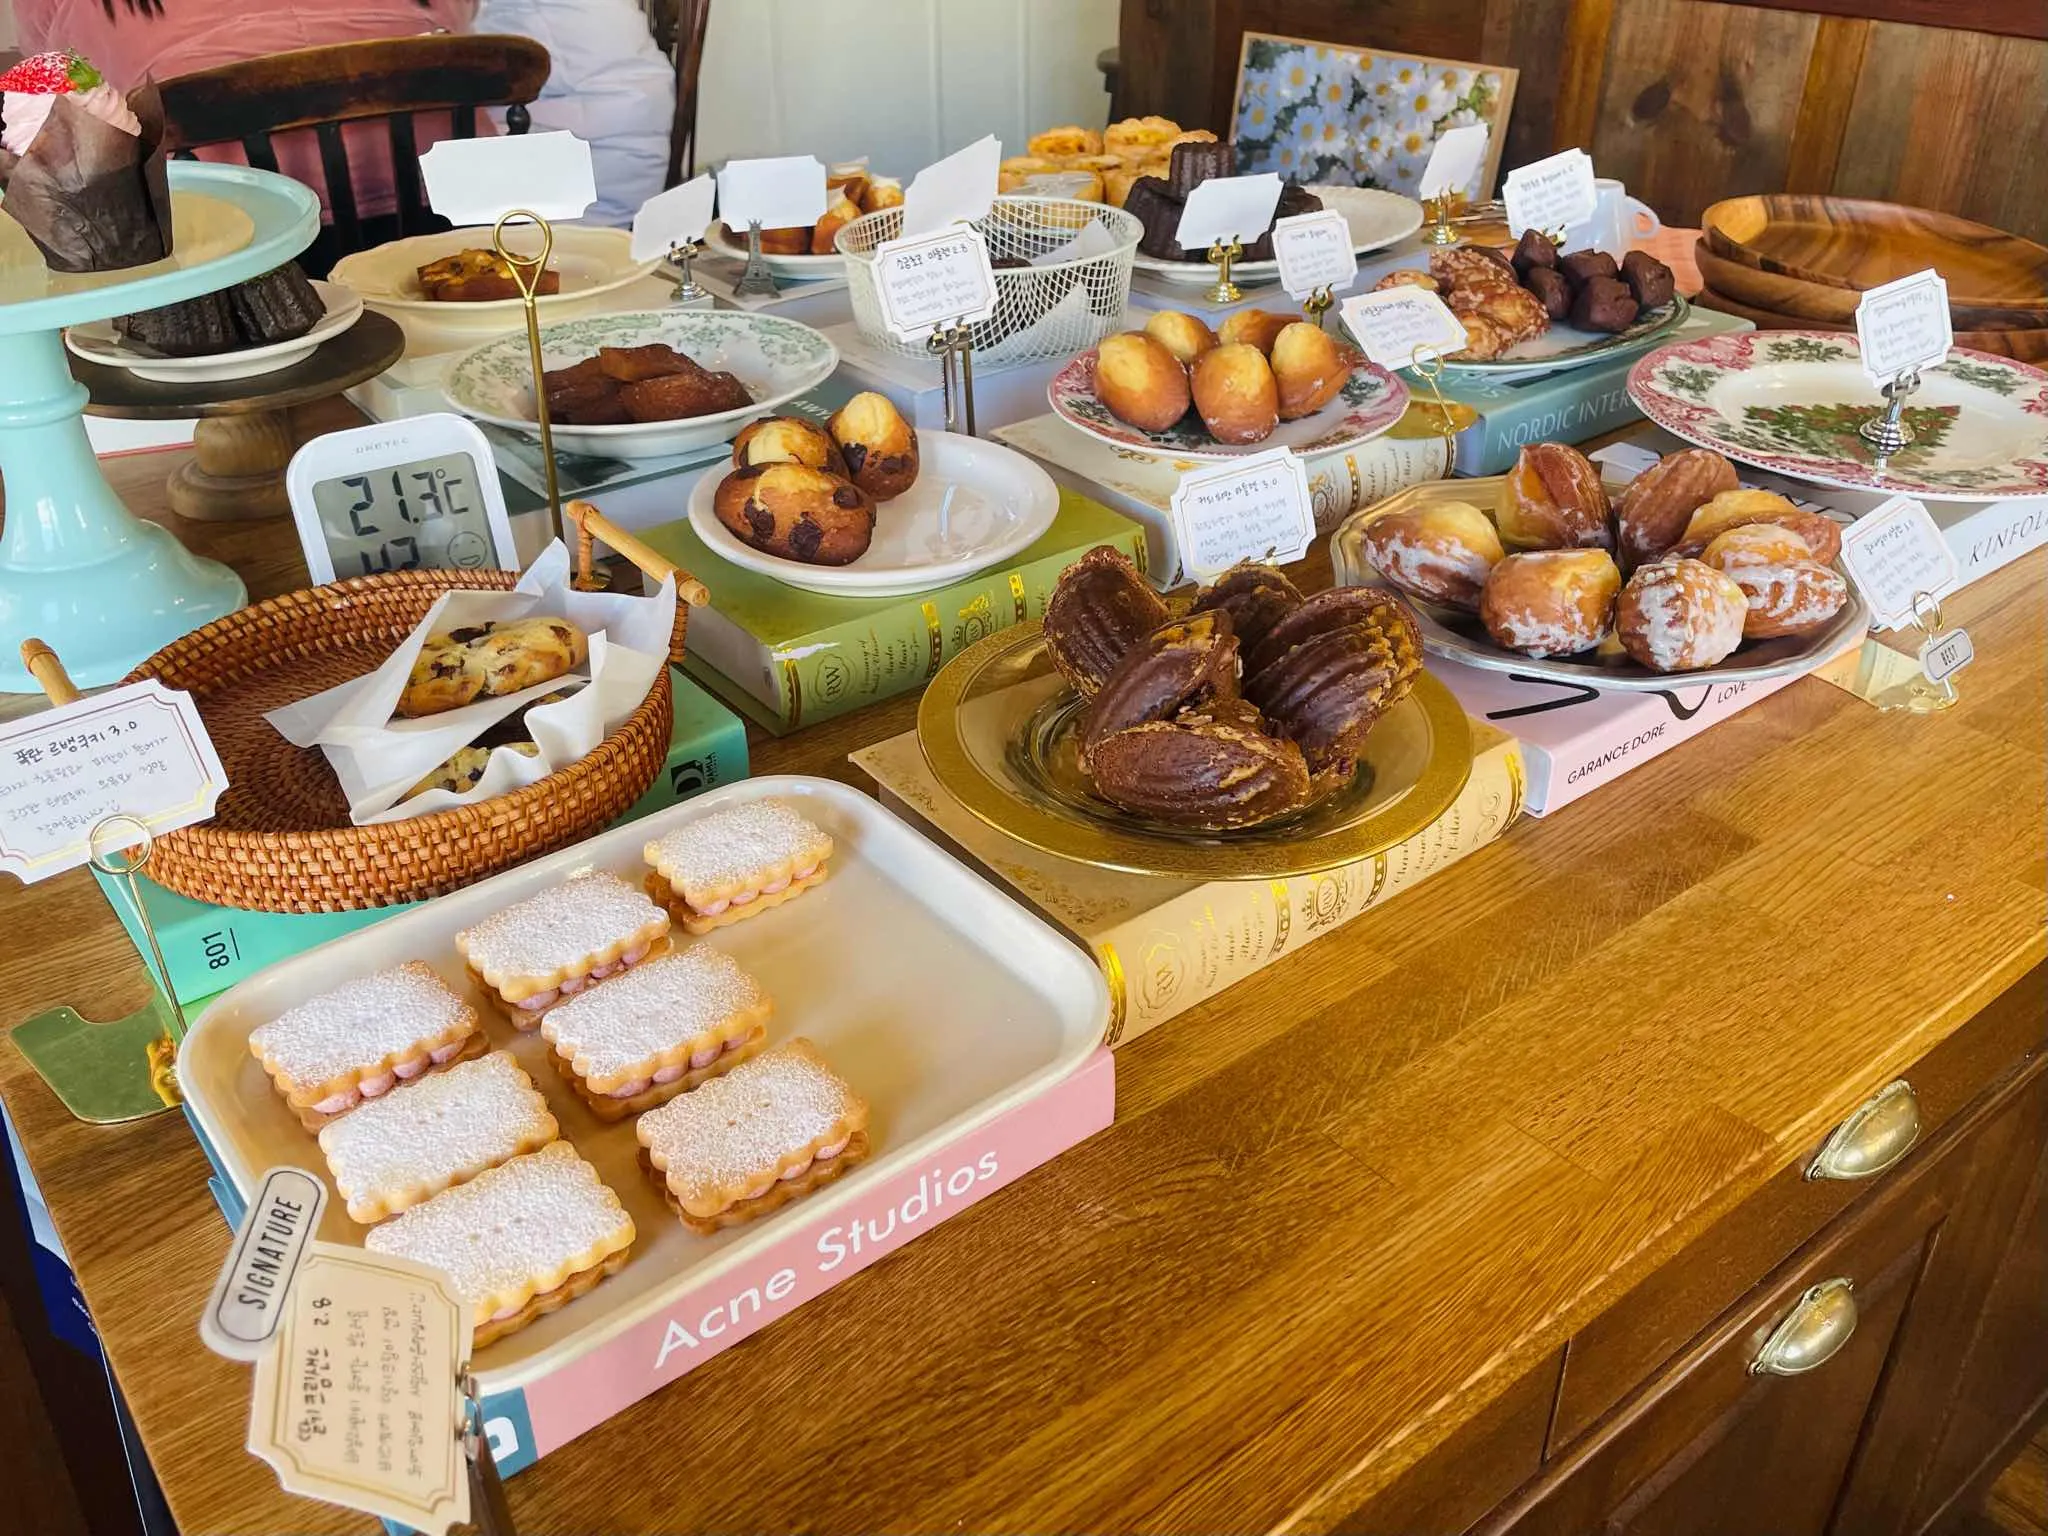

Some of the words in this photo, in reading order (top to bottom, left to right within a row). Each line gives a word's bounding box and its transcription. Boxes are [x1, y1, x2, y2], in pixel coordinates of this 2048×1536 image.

[1497, 405, 1574, 451] NORDIC
[1969, 509, 2048, 566] KINFOL
[1941, 644, 1959, 666] BEST
[1717, 680, 1748, 704] LOVE
[108, 720, 138, 736] 3.0
[1567, 741, 1630, 785] GARANCE
[202, 931, 230, 970] 801
[237, 1195, 304, 1312] SIGNATURE
[654, 1267, 797, 1370] Acne
[816, 1150, 999, 1272] Studios
